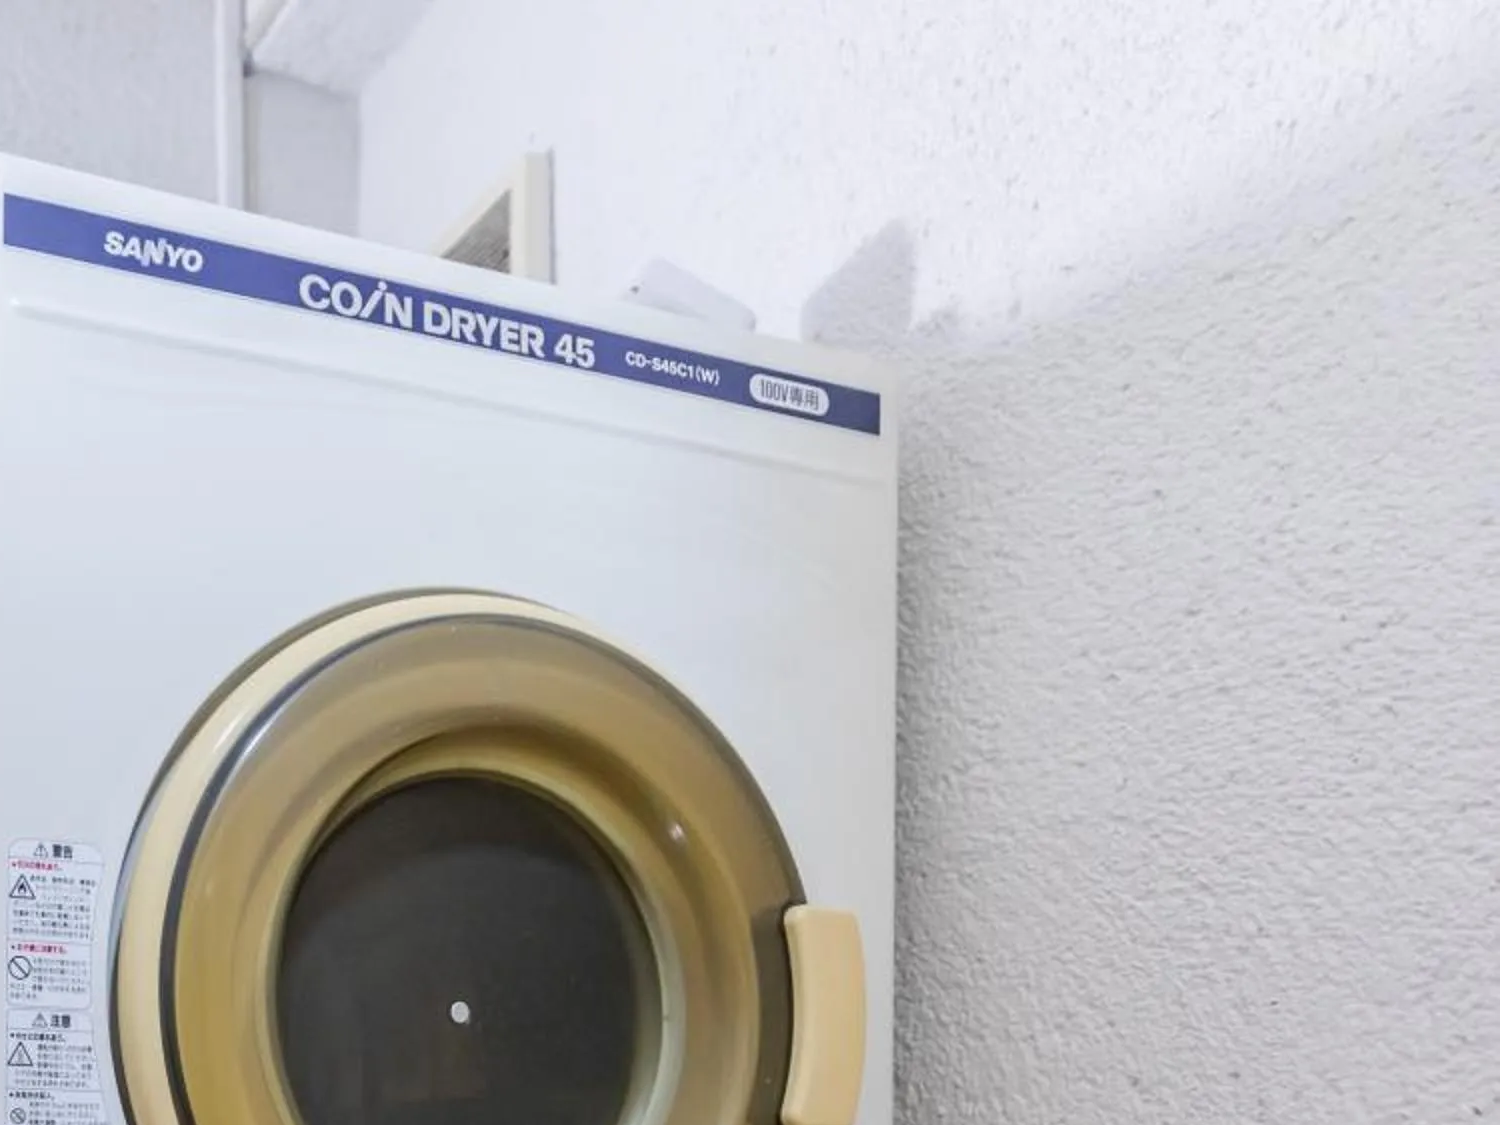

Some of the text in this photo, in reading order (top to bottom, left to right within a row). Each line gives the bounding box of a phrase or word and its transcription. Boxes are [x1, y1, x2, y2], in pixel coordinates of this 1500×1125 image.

[103, 230, 204, 273] SANYO
[422, 300, 545, 358] DRYER
[554, 335, 596, 369] 45
